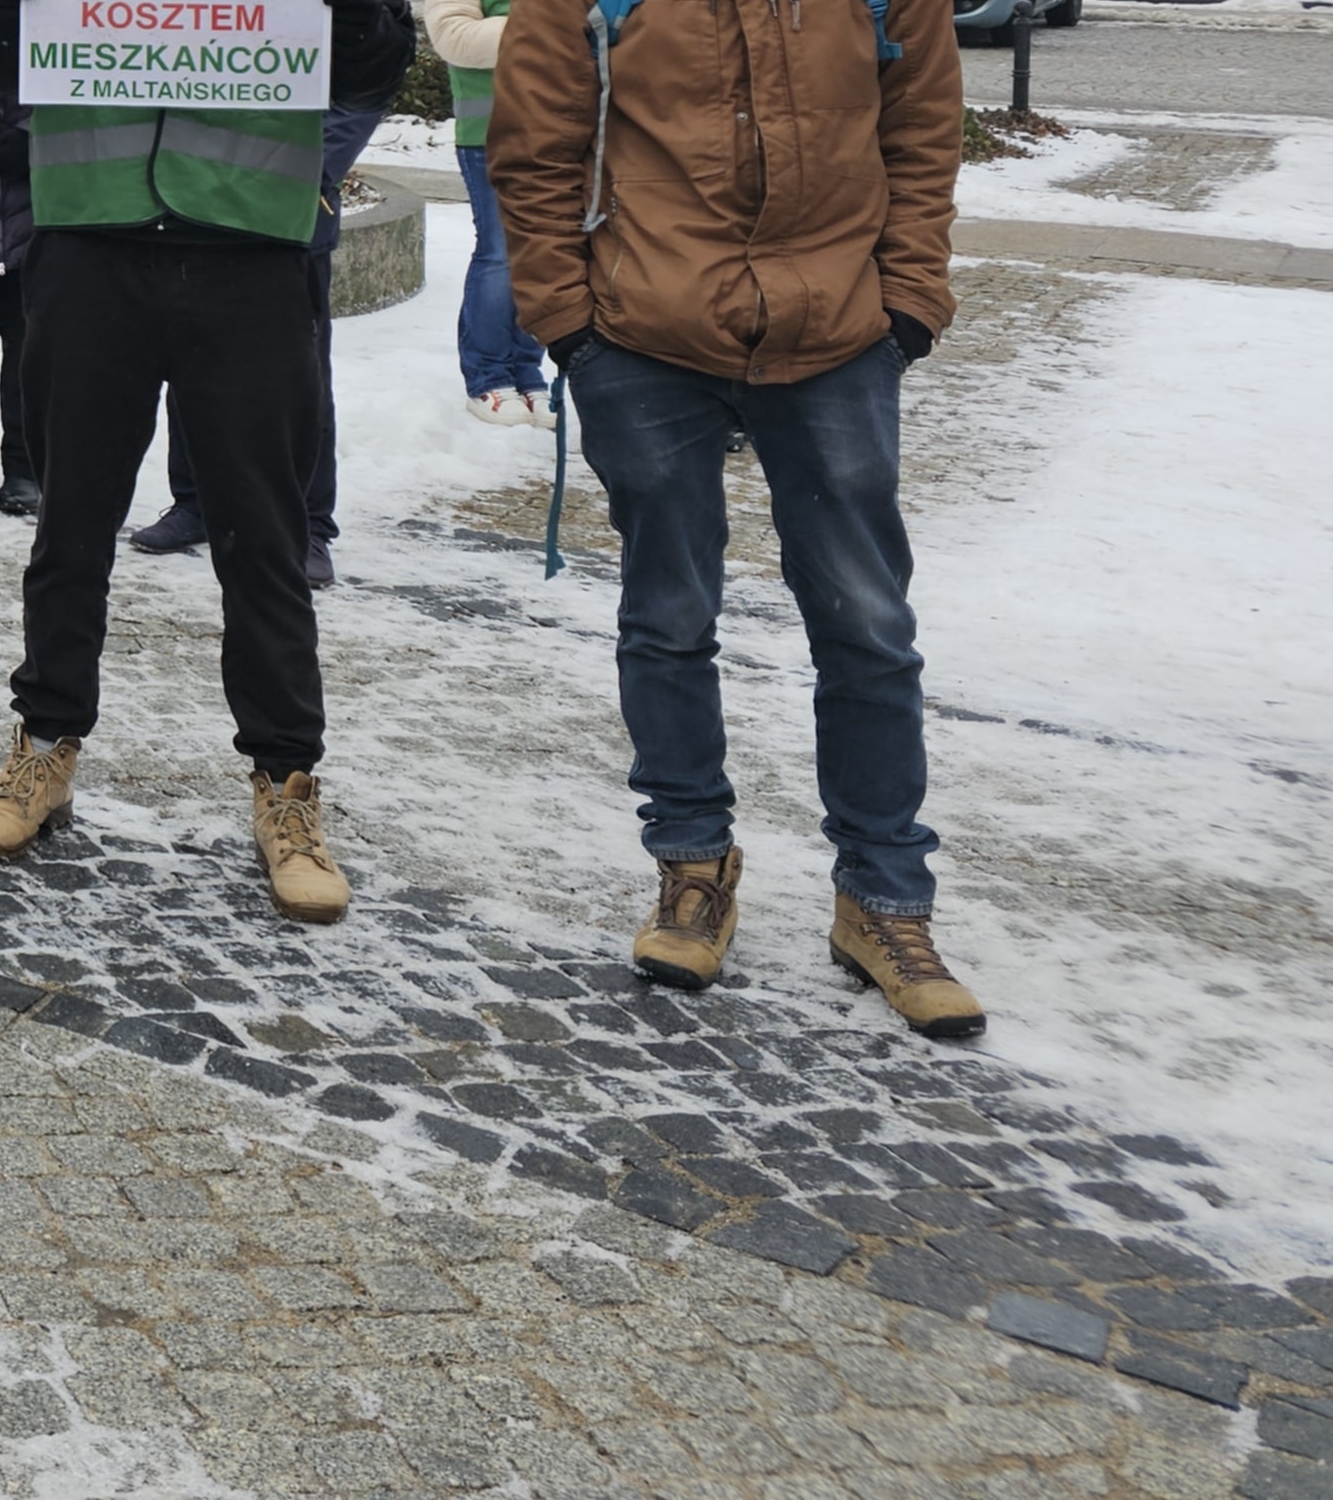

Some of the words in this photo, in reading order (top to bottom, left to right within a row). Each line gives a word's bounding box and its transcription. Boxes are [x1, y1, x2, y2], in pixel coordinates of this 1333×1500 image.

[81, 1, 265, 32] KOSZTEM
[29, 39, 320, 74] MIESZKAŃCÓW
[70, 79, 84, 97] Z
[93, 77, 291, 102] MALTAŃSKIEGO
